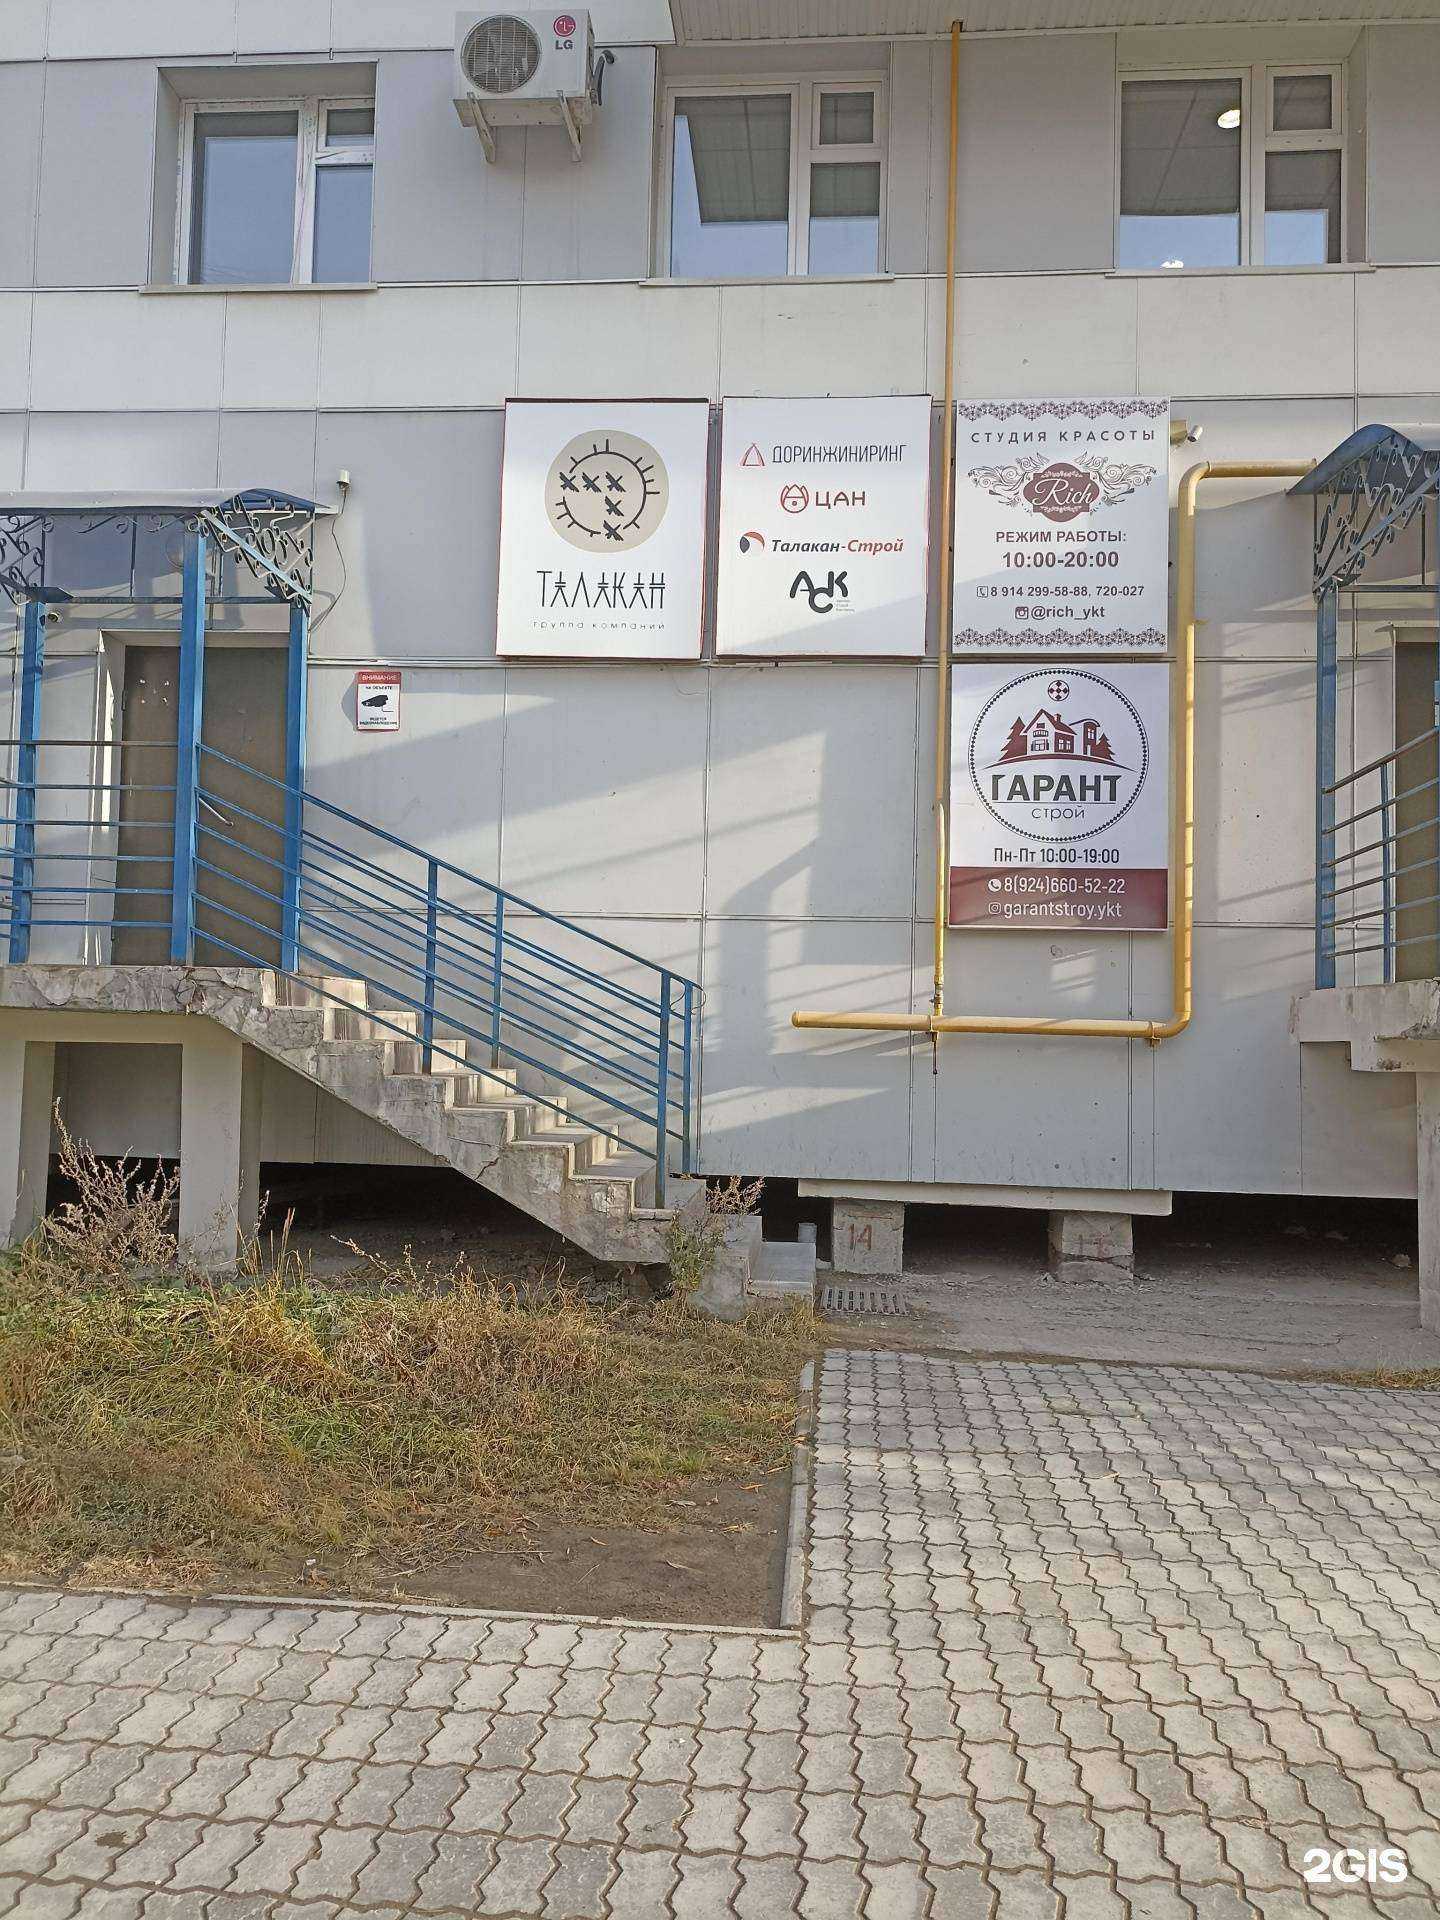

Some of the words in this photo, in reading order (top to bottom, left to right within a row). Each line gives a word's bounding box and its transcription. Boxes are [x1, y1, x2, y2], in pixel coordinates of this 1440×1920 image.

[555, 39, 574, 50] LG
[971, 431, 1047, 444] СТУДИЯ
[1059, 430, 1155, 442] КРАСОТЫ
[772, 444, 907, 463] ДОРИНЖИНИРИНГ
[815, 491, 866, 509] ЦАН
[1031, 477, 1093, 506] Rich
[996, 532, 1051, 543] РЕЖИМ
[1056, 531, 1127, 542] РАБОТЫ:
[772, 539, 904, 555] Талакан-Строй
[1002, 551, 1120, 568] 10:00-20:00
[536, 570, 666, 609] ТАЛАКАН
[990, 587, 998, 597] 8
[1000, 587, 1024, 597] 914
[1027, 587, 1092, 598] 299-58-88,
[1096, 586, 1145, 597] 720-027
[1031, 606, 1105, 620] @rich_ykt
[533, 621, 584, 630] группа
[991, 774, 1122, 802] ГАРАНТ
[1031, 805, 1085, 822] строй
[994, 848, 1036, 862] Пн-Пт
[1040, 848, 1120, 863] 10:00-19:00
[1004, 877, 1126, 895] 8(924)660-52-22
[1004, 901, 1122, 919] garantstroy.ykt
